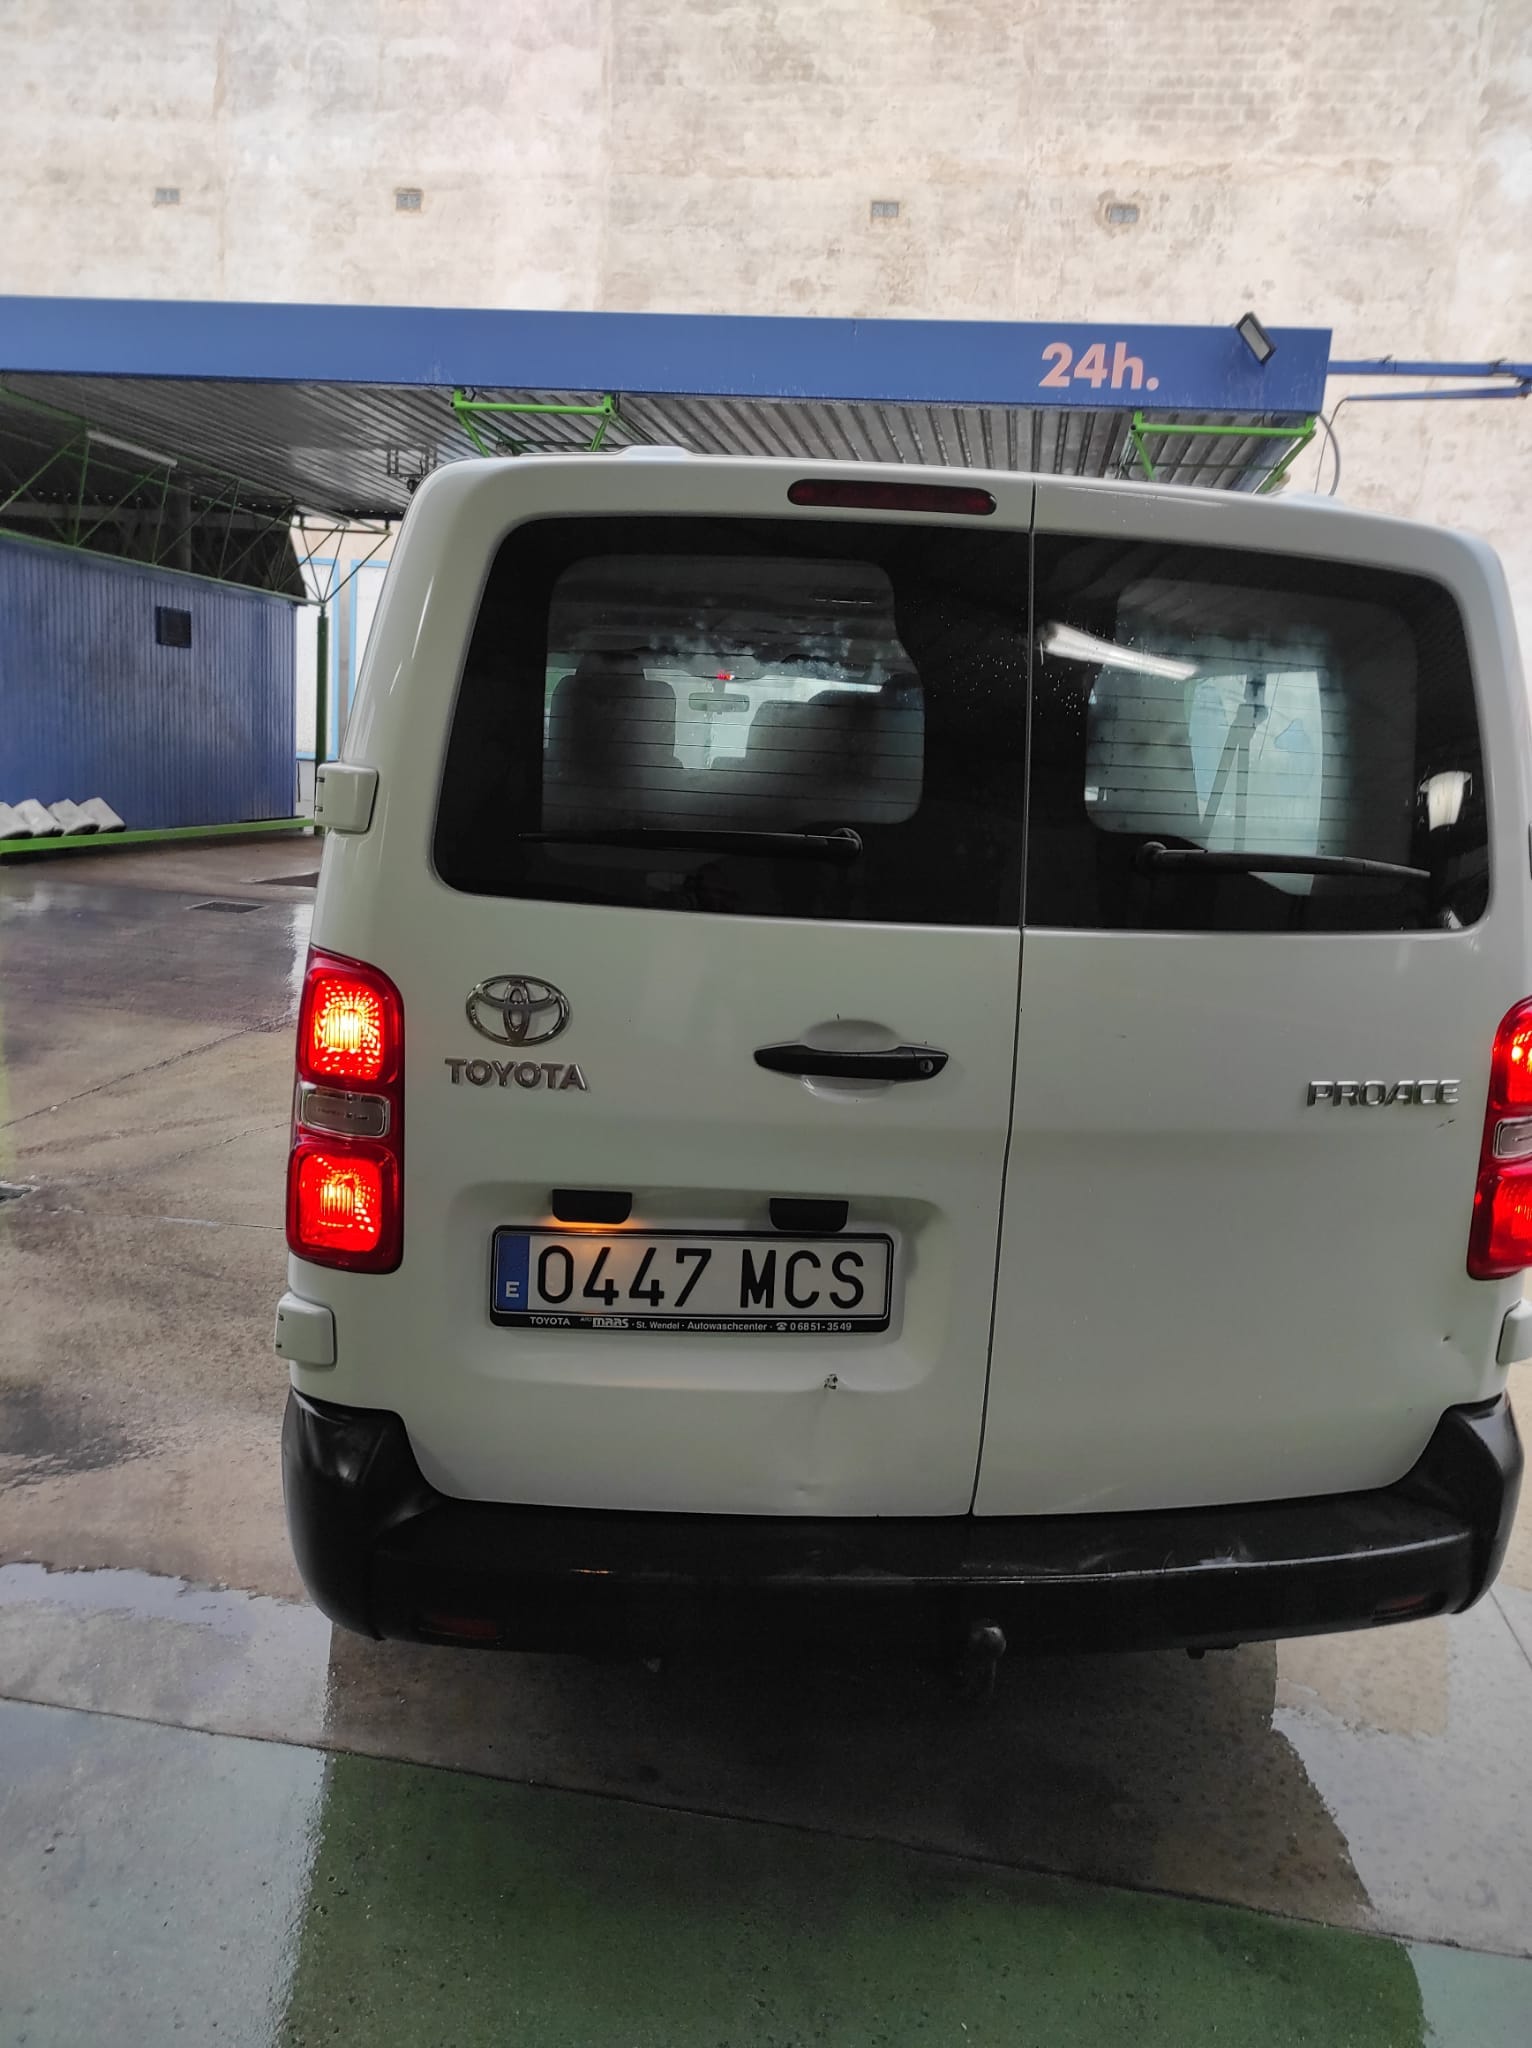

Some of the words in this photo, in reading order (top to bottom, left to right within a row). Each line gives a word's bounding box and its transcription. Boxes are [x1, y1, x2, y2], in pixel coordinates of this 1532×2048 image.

[1038, 341, 1160, 391] 24h.
[444, 1057, 588, 1091] TOYOTA
[1306, 1079, 1462, 1107] PROACE
[505, 1281, 520, 1298] E
[537, 1244, 712, 1307] 0447
[739, 1248, 864, 1309] MCS
[529, 1316, 571, 1326] TOYOTA
[636, 1320, 647, 1329] St.
[649, 1321, 680, 1330] Wendel
[686, 1321, 768, 1331] Autowaschcenter
